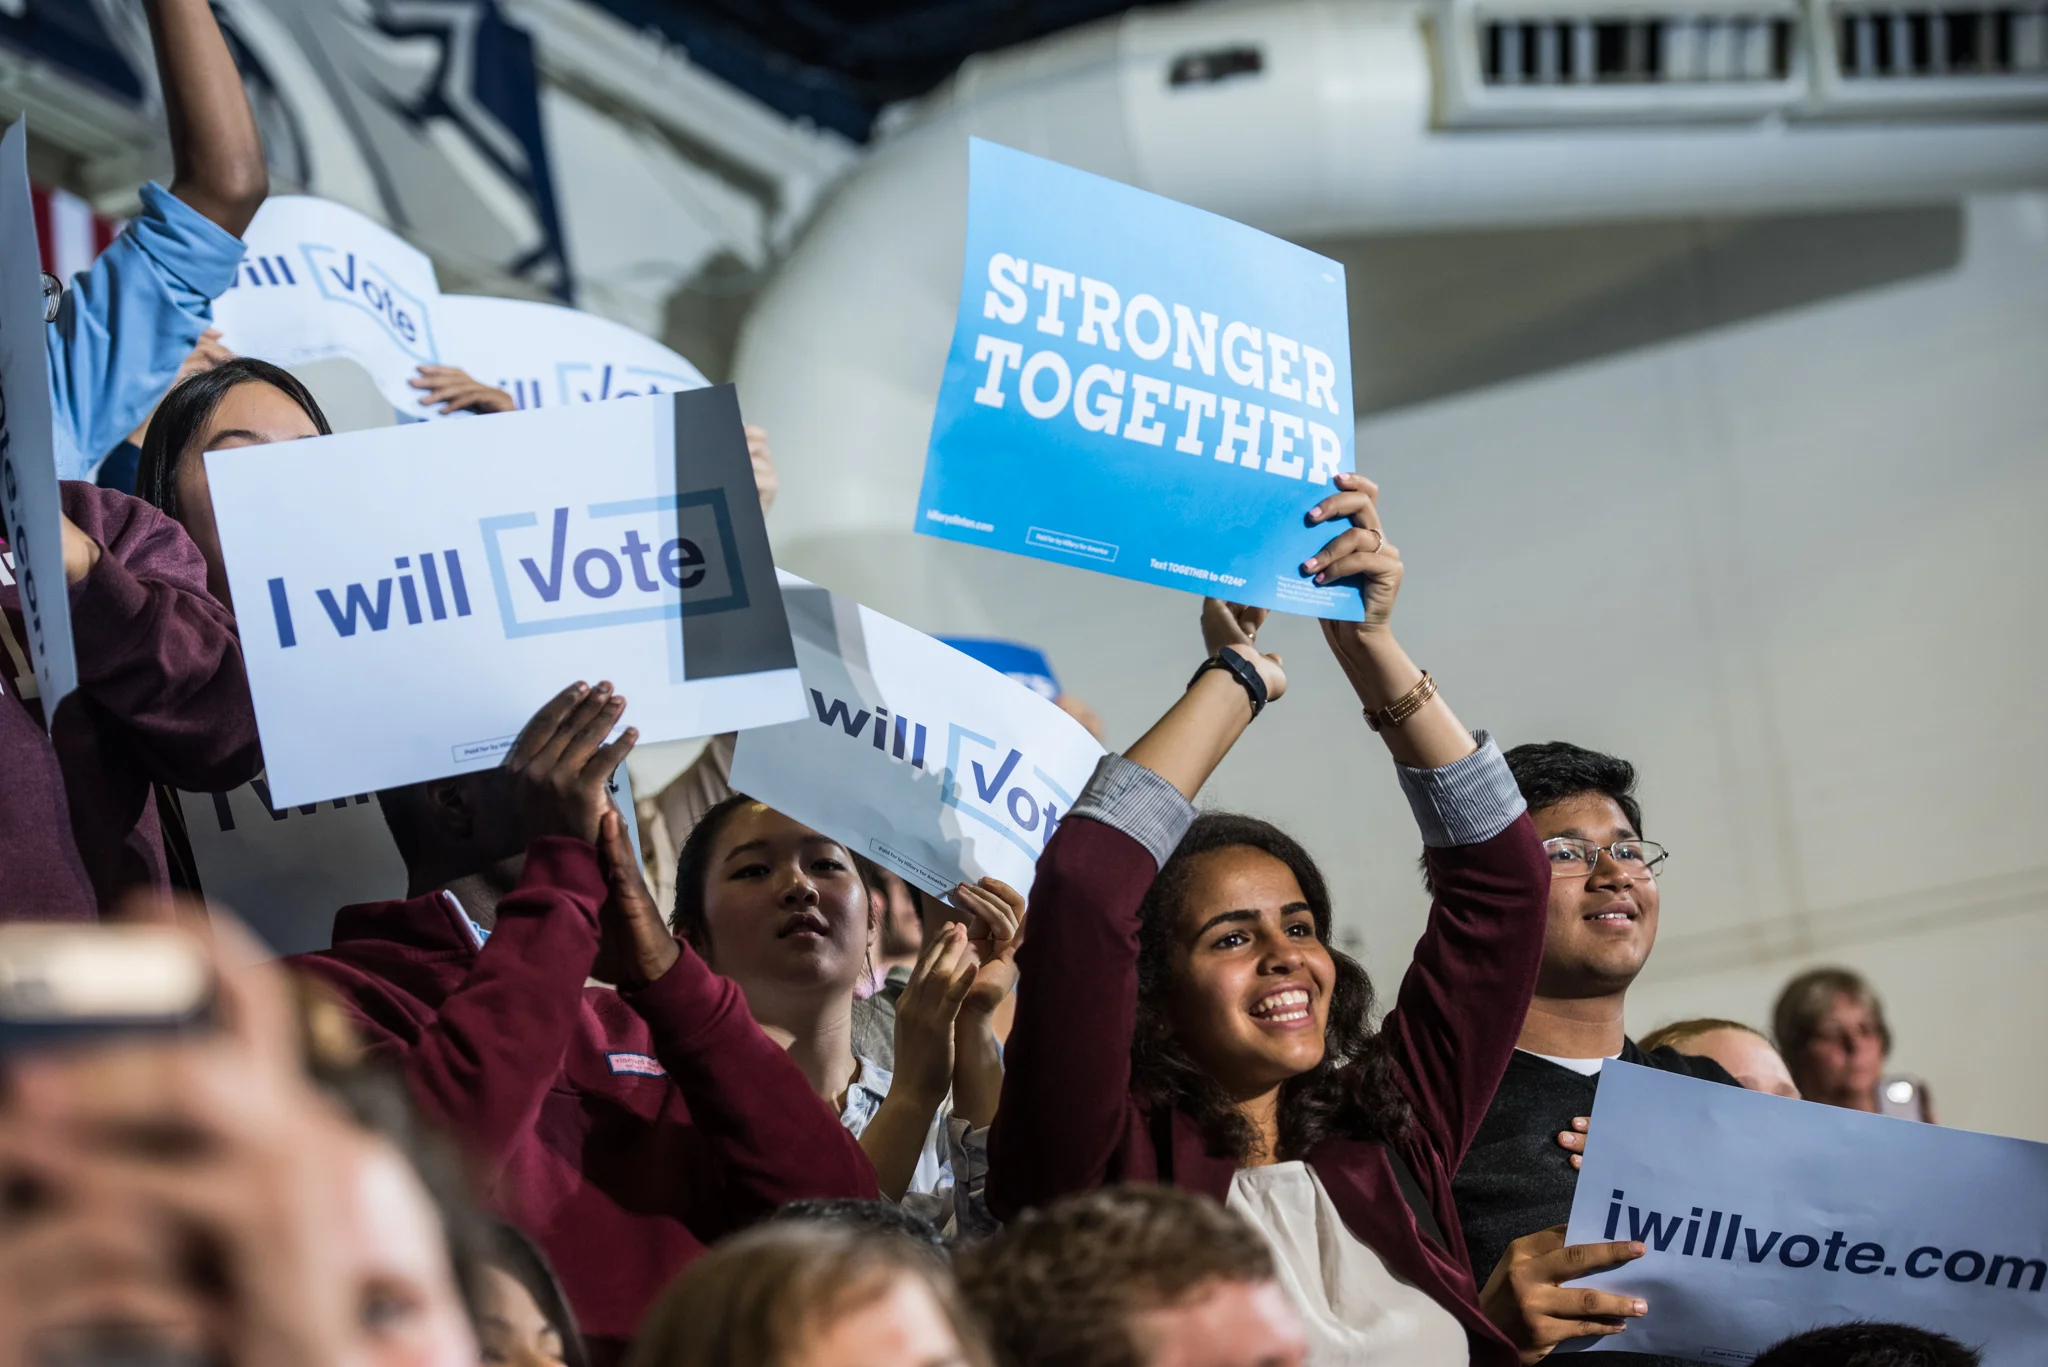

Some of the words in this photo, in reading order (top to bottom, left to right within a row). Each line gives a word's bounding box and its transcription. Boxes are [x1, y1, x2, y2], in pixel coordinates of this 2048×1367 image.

[231, 255, 297, 288] ill
[983, 252, 1340, 415] STRONGER
[974, 334, 1342, 486] TOGETHER
[267, 577, 297, 648] I
[315, 549, 472, 638] will
[1150, 557, 1168, 571] Text
[1168, 562, 1209, 581] TOGETHER
[1209, 572, 1218, 582] to
[810, 688, 927, 769] will
[971, 748, 1061, 848] Vot
[878, 846, 891, 856] Paid
[897, 856, 904, 864] by
[903, 860, 919, 873] Hillary
[919, 869, 927, 877] for
[927, 874, 948, 889] America
[1603, 1189, 2048, 1292] iwillvote.com
